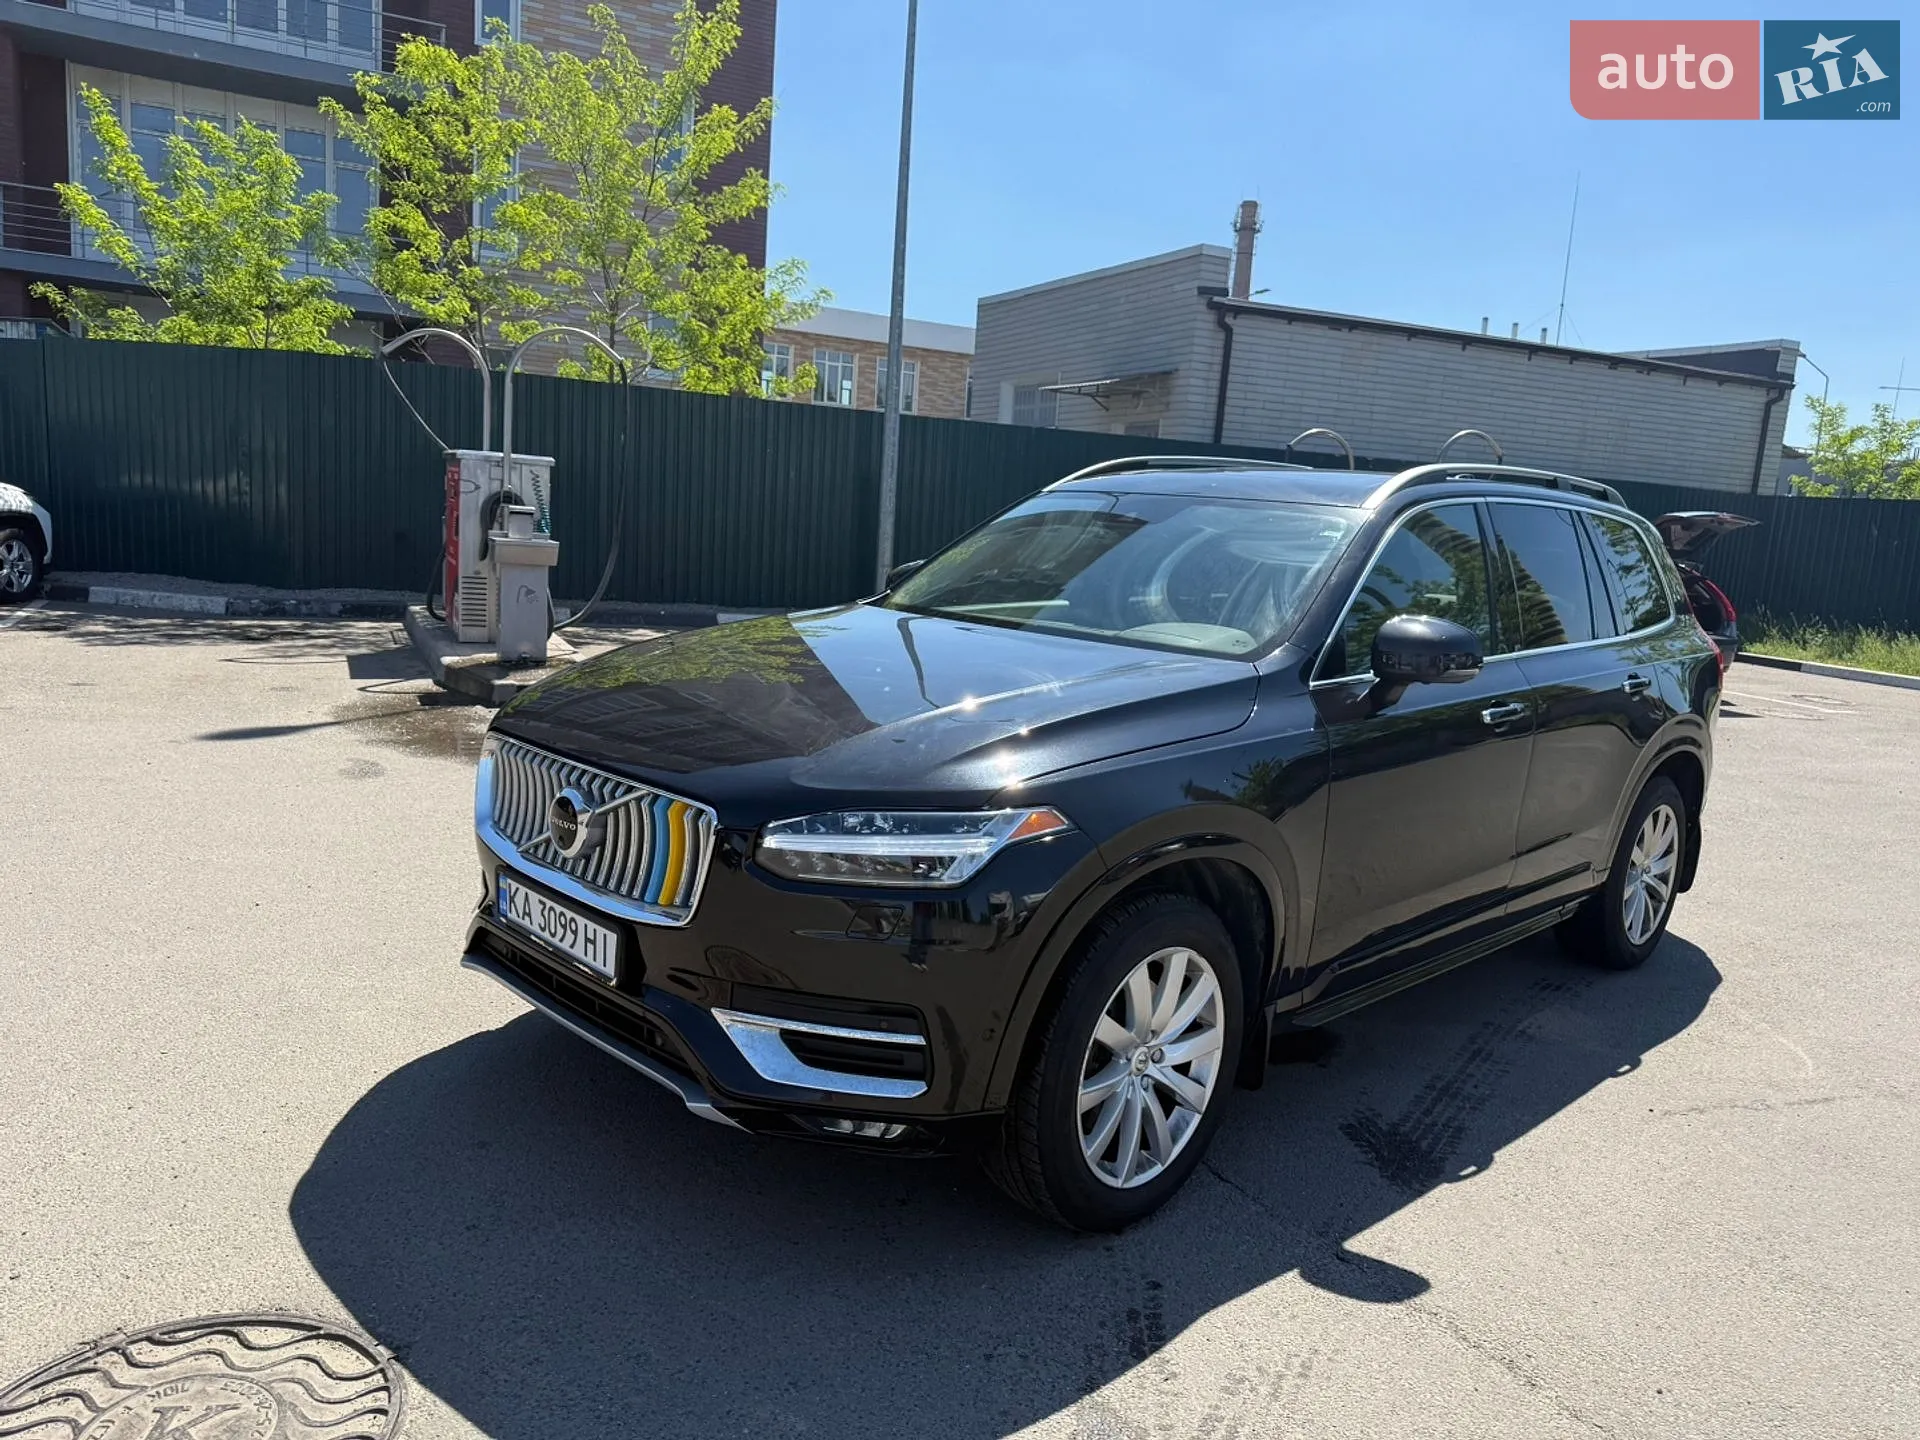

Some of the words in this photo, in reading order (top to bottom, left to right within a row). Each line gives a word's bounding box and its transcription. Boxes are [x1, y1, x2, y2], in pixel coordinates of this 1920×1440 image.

[508, 882, 533, 926] KA
[537, 899, 579, 949] 3099
[584, 923, 607, 968] HI
